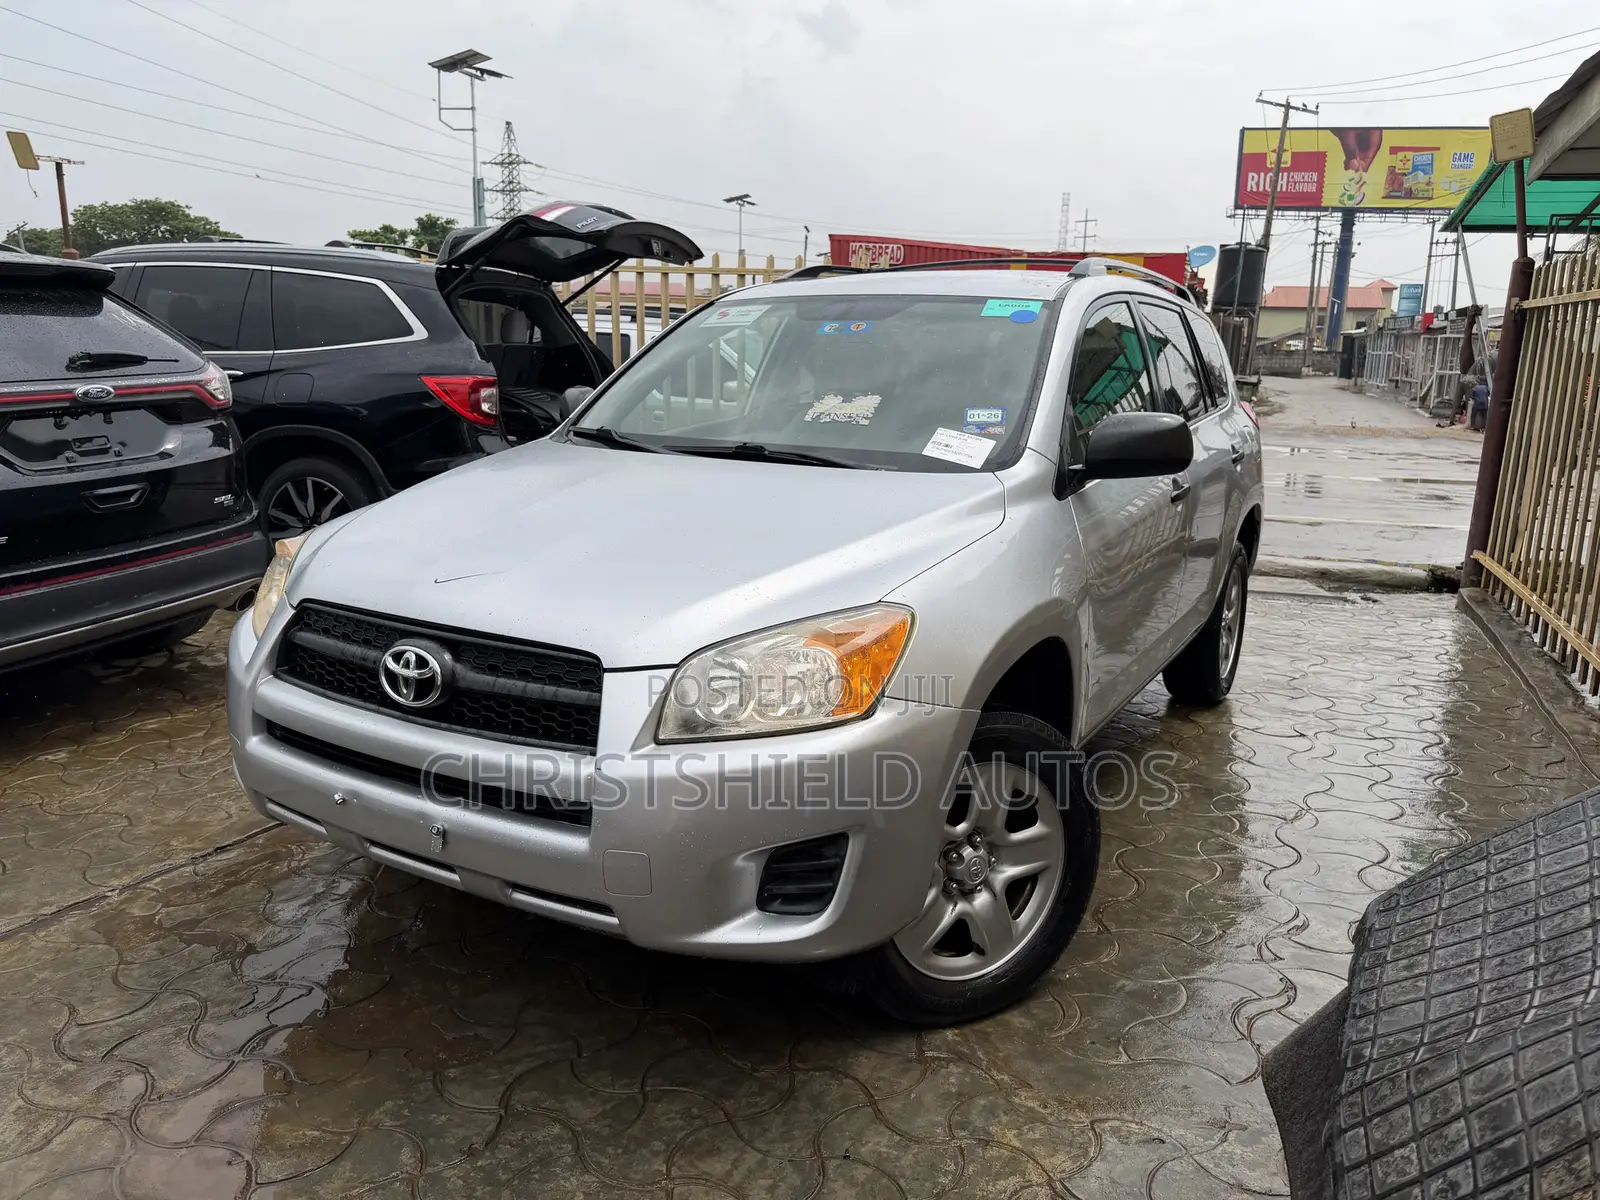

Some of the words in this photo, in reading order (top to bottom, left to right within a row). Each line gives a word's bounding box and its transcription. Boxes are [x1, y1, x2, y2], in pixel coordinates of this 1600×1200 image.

[1289, 172, 1318, 182] CHICKEN
[1287, 182, 1317, 193] FLAVOUR
[576, 217, 597, 228] PILOT
[88, 388, 108, 398] Ford
